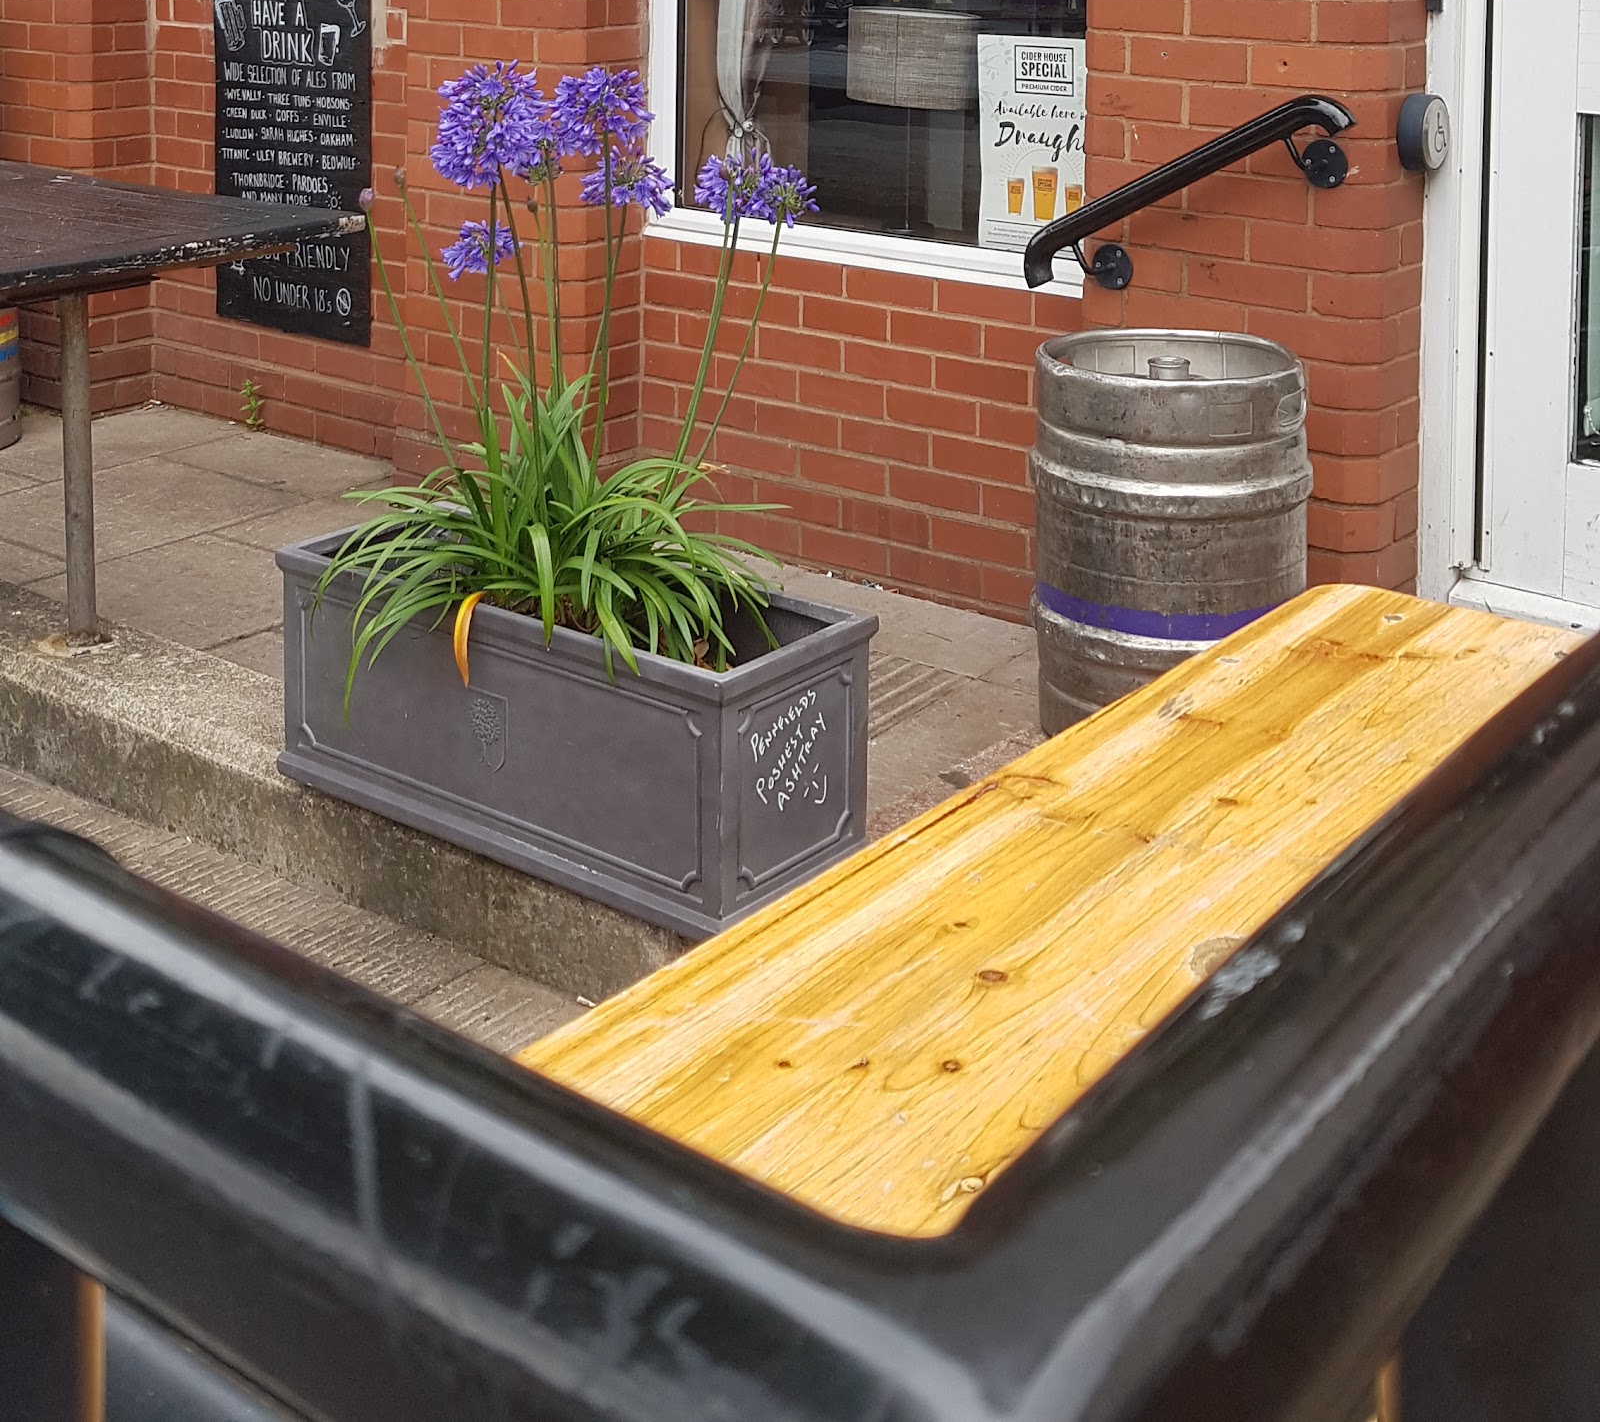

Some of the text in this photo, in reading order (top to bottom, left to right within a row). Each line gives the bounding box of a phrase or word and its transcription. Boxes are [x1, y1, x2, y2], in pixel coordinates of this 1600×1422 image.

[253, 0, 304, 26] HAVE A
[263, 30, 312, 62] DRINK
[1021, 51, 1067, 63] CIDER HOUSE
[223, 61, 356, 91] WIDE SELECTION OF ALES FROM
[1021, 61, 1068, 79] SPECIAL
[267, 92, 291, 106] THREE
[292, 94, 312, 108] TUNS
[316, 97, 350, 111] HOBSONS
[994, 100, 1048, 118] Available
[1050, 104, 1077, 119] here
[313, 113, 347, 128] ENVILLE
[225, 126, 254, 140] LUDLOW
[260, 126, 284, 142] SARAH
[320, 132, 354, 147] OAKHAM
[221, 147, 357, 170] TITANIC ULEY BREWERY BEOWULF
[291, 173, 329, 194] PARDOES
[253, 275, 272, 302] NO
[275, 280, 311, 311] UNDER
[756, 722, 804, 805] POSHEST
[777, 711, 827, 812] ASHTRAY
